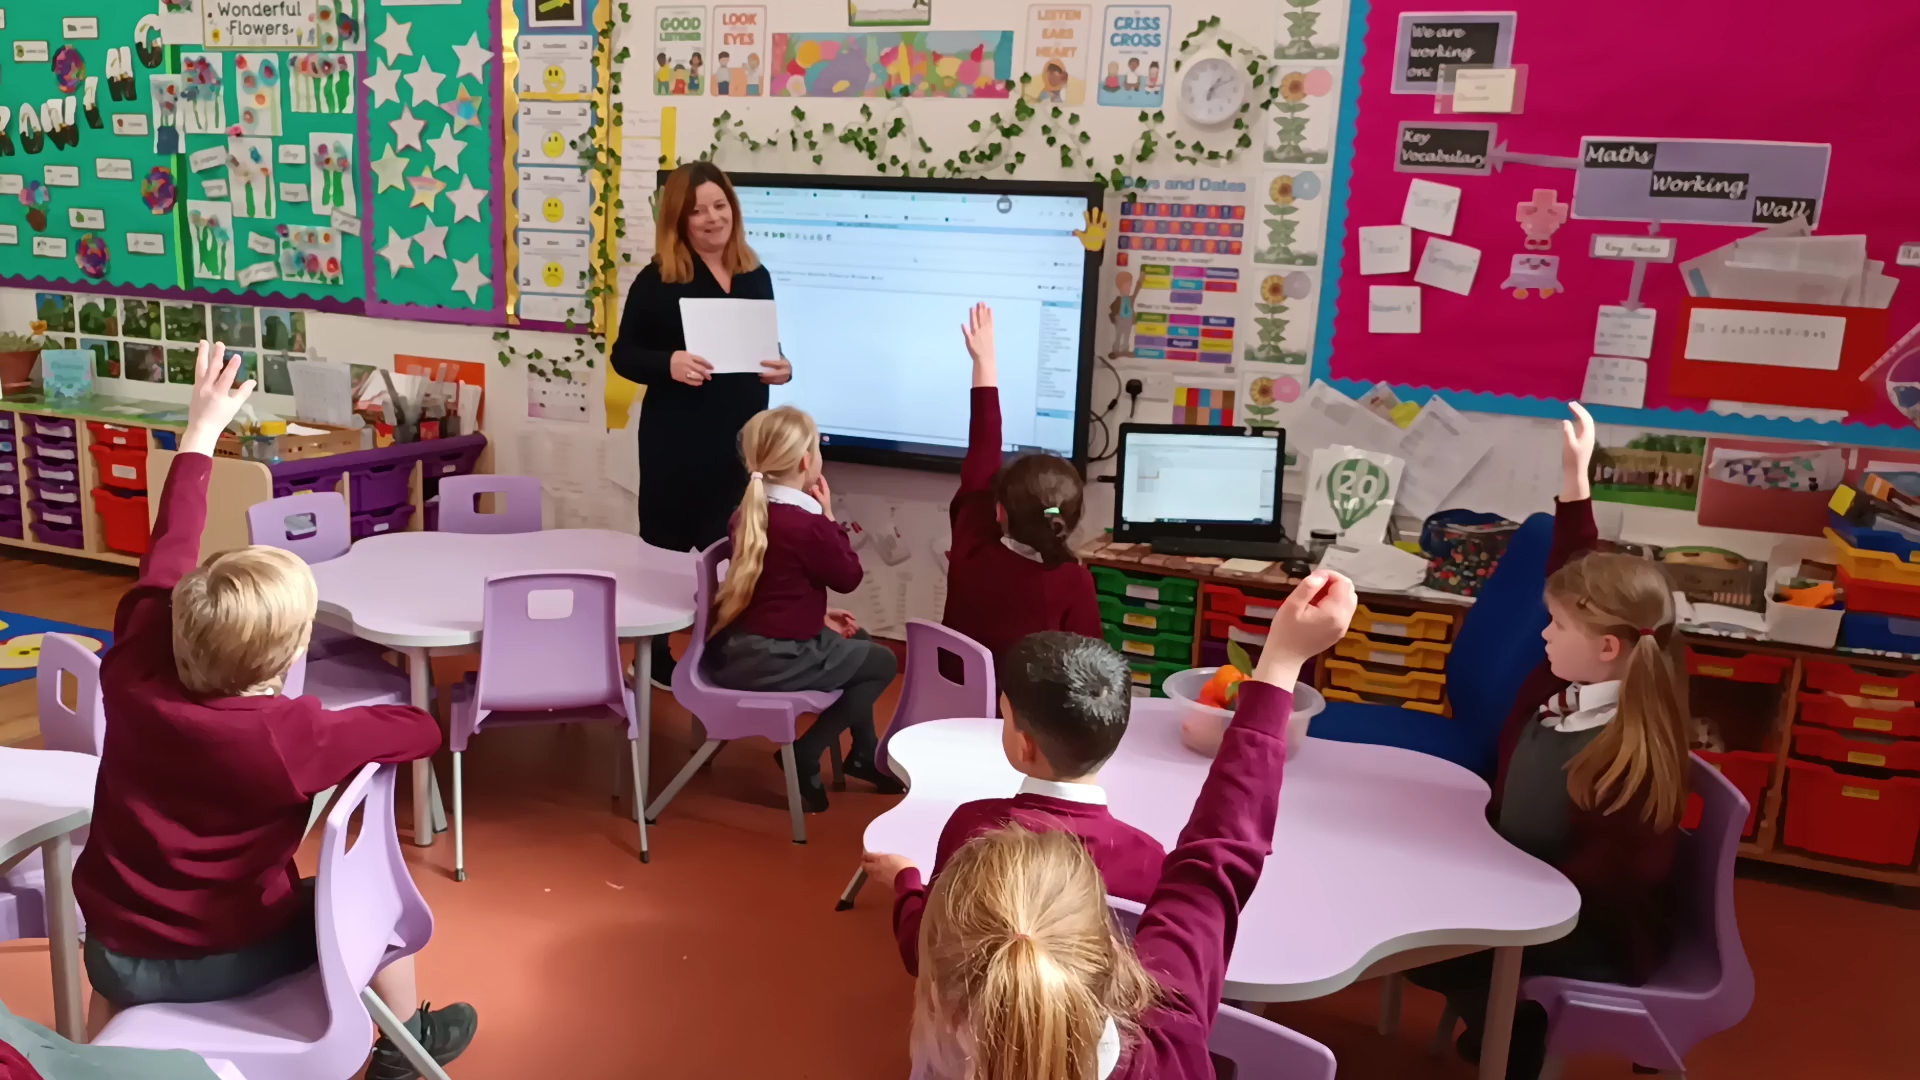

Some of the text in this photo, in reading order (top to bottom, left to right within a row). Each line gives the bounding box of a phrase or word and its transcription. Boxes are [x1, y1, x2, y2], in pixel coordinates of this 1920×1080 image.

[217, 0, 302, 17] Wonderful
[229, 20, 289, 35] Flowers
[660, 17, 701, 31] GOOD
[722, 13, 757, 26] LOOK
[1114, 16, 1161, 31] CRISS
[723, 33, 755, 45] EYES
[1110, 32, 1162, 47] CROSS
[1412, 25, 1467, 38] We are
[1410, 44, 1476, 62] working
[1403, 130, 1432, 146] Key
[1402, 148, 1487, 168] Vocabulary
[1585, 144, 1653, 164] Maths
[1121, 176, 1160, 192] Dys
[1164, 178, 1195, 190] and
[1652, 174, 1749, 199] Working
[1755, 200, 1811, 218] Wall
[1337, 470, 1378, 498] 20
